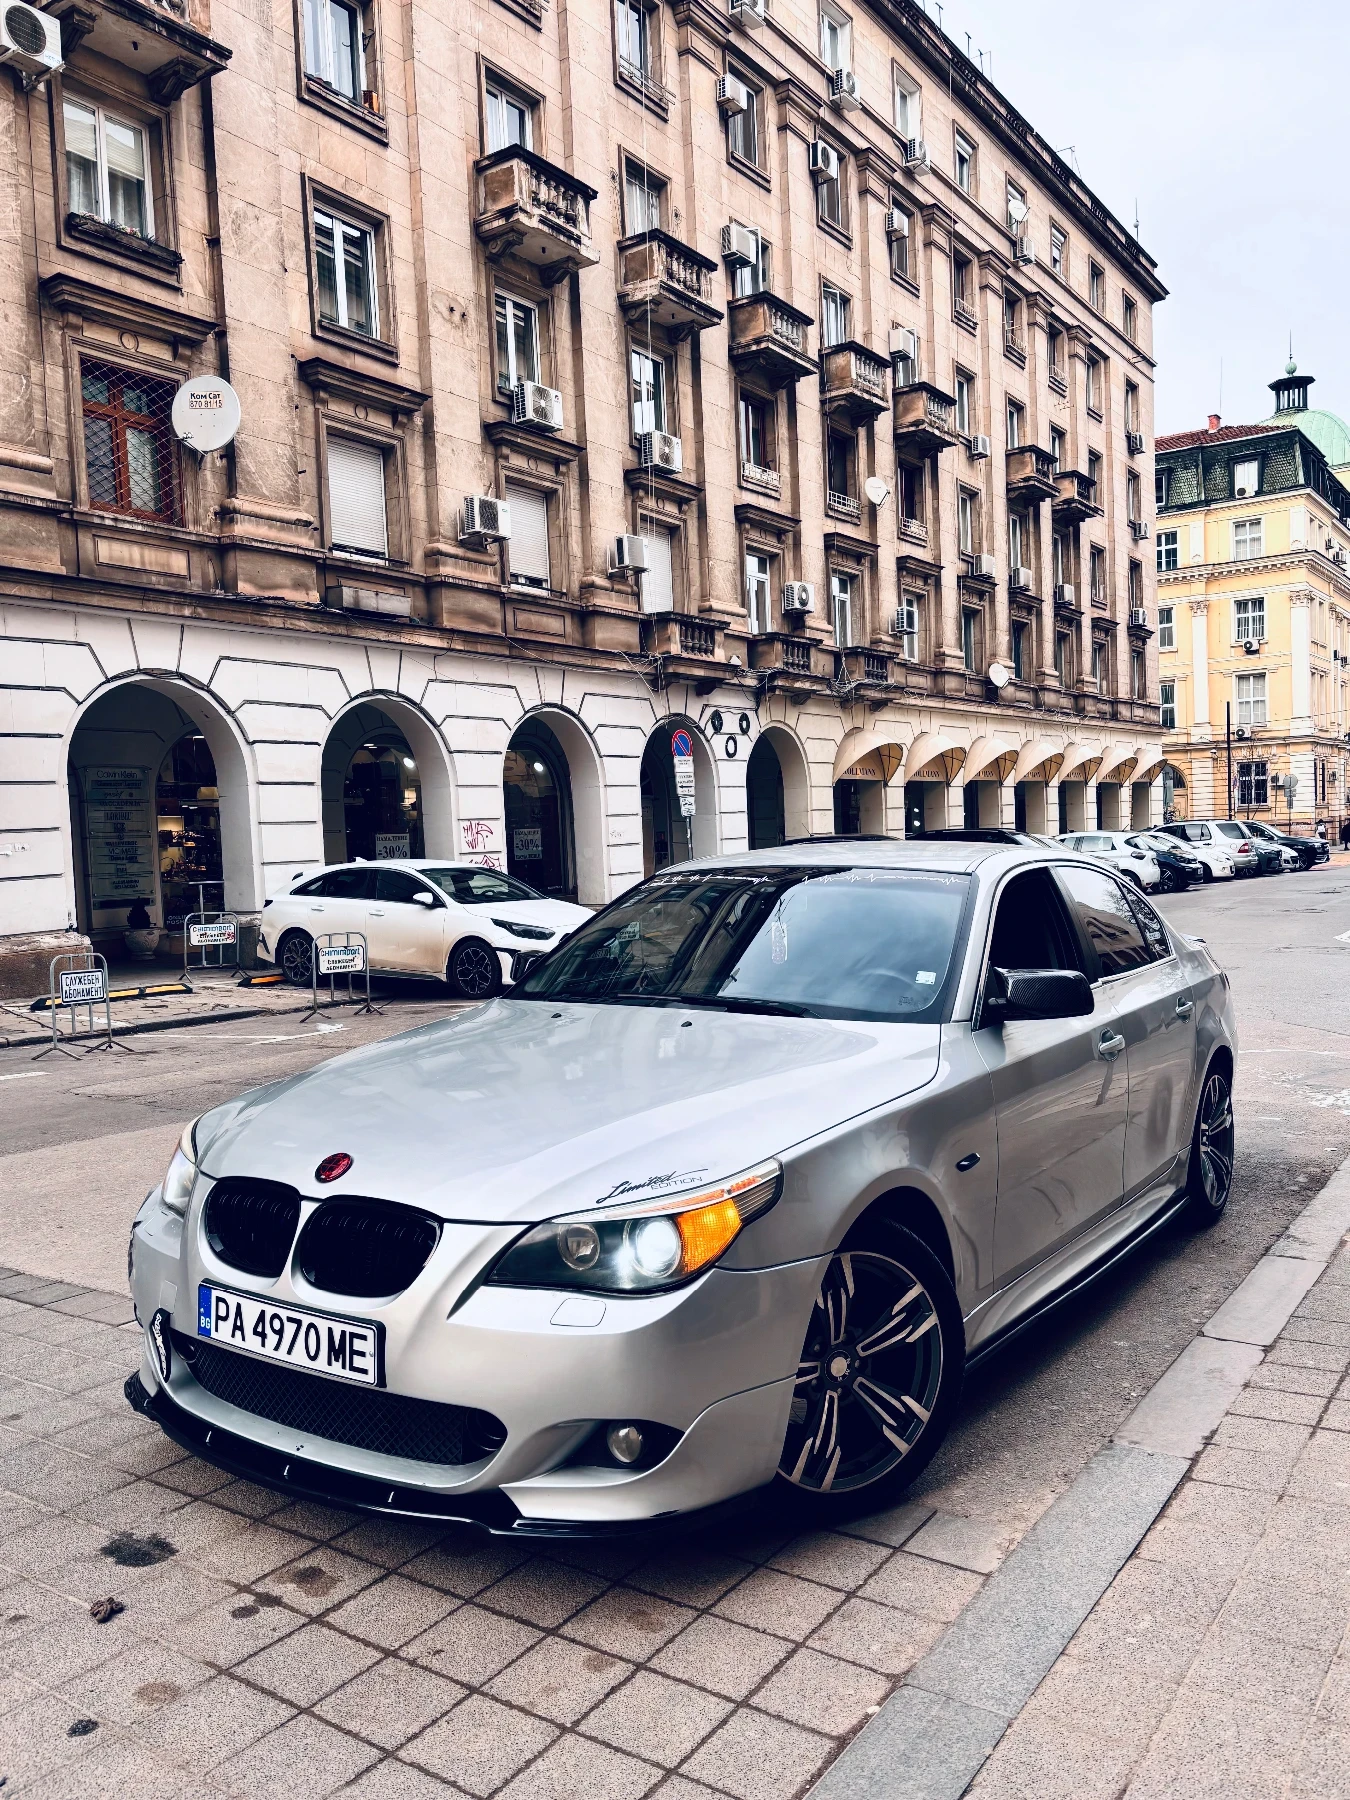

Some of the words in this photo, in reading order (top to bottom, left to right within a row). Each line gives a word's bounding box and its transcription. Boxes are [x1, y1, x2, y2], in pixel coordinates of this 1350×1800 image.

[190, 392, 207, 400] Ком
[208, 392, 221, 400] Сат
[96, 770, 120, 779] Calvin
[120, 770, 138, 779] Klein
[65, 974, 100, 987] СЛУЖЕБЕН
[64, 986, 102, 1000] АБОНАМЕНТ
[595, 1170, 690, 1204] Limited
[650, 1176, 703, 1190] EDITION
[200, 1315, 211, 1329] BG
[214, 1295, 246, 1342] PA
[252, 1309, 321, 1362] 4970
[327, 1326, 369, 1376] ME
